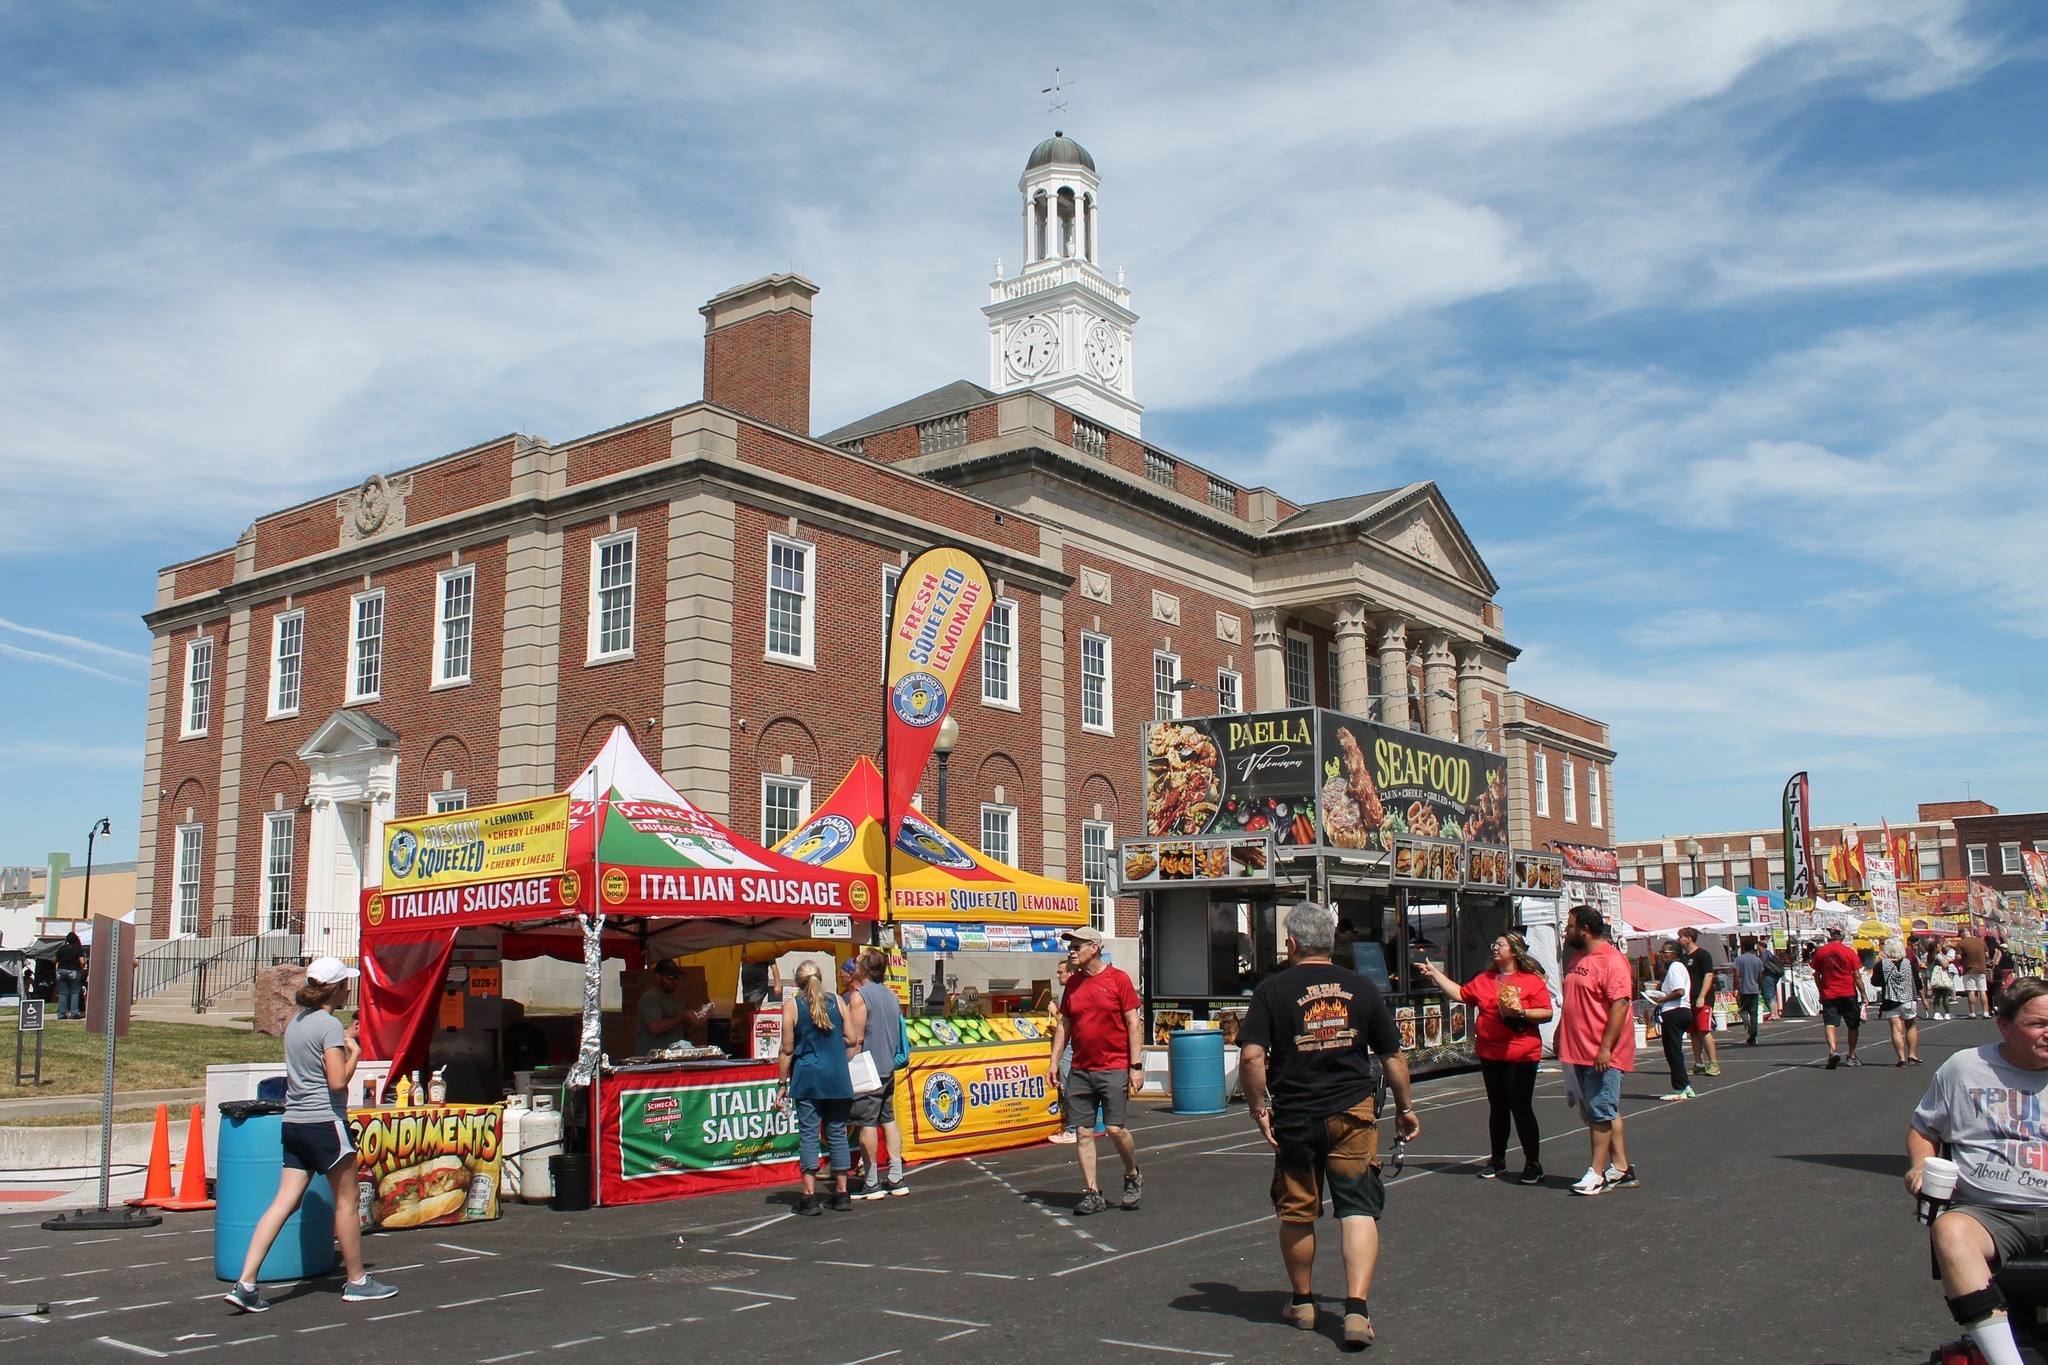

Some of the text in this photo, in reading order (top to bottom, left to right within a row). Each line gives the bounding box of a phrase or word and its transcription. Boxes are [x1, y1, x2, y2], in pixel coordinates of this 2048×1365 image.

[899, 574, 939, 641] FRESH
[909, 567, 965, 665] SQUEEZED
[932, 580, 982, 671] LEMONADE
[895, 674, 943, 696] SUGAR DADDY'S
[899, 709, 940, 725] LEMONADE
[1230, 717, 1312, 751] PAELLA
[1375, 738, 1471, 804] SEAFOOD
[1380, 789, 1466, 815] CAJUN CREOLE GRILLED FRIED
[490, 810, 534, 826] LEMONADE
[617, 803, 713, 827] SCIMECA'S
[422, 819, 479, 848] FRESHLY
[493, 827, 524, 841] CHERRY
[525, 820, 566, 836] LEMONADE
[636, 823, 728, 840] SAUSAGE COMPANY
[822, 817, 851, 843] DADDY'S
[1789, 782, 1808, 897] ITALIAN
[418, 840, 485, 878] SQUEEZED
[492, 842, 525, 855] LIMEADE
[490, 852, 556, 870] CHERRY LIMEADE
[391, 877, 552, 920] ITALIAN SAUSAGE
[640, 873, 842, 906] ITALIAN SAUSAGE
[895, 888, 1080, 912] FRESH SQUEEZED LEMONADE
[815, 919, 848, 928] FOOD LINE
[992, 940, 1009, 948] MANGO
[472, 978, 497, 988] 6228-2
[756, 1021, 780, 1029] SCIMECA'S
[985, 1064, 1030, 1082] FRESH
[925, 1074, 962, 1099] SUGAR DADDY'S
[969, 1076, 1045, 1107] SQUEEZED
[647, 1099, 678, 1111] SCIMECA'S
[645, 1113, 682, 1124] ITALIAN SAUSAGE
[703, 1110, 800, 1144] SAUSAGE
[929, 1112, 961, 1129] LEMONADE
[773, 1151, 792, 1159] spices
[1970, 1162, 2013, 1182] About
